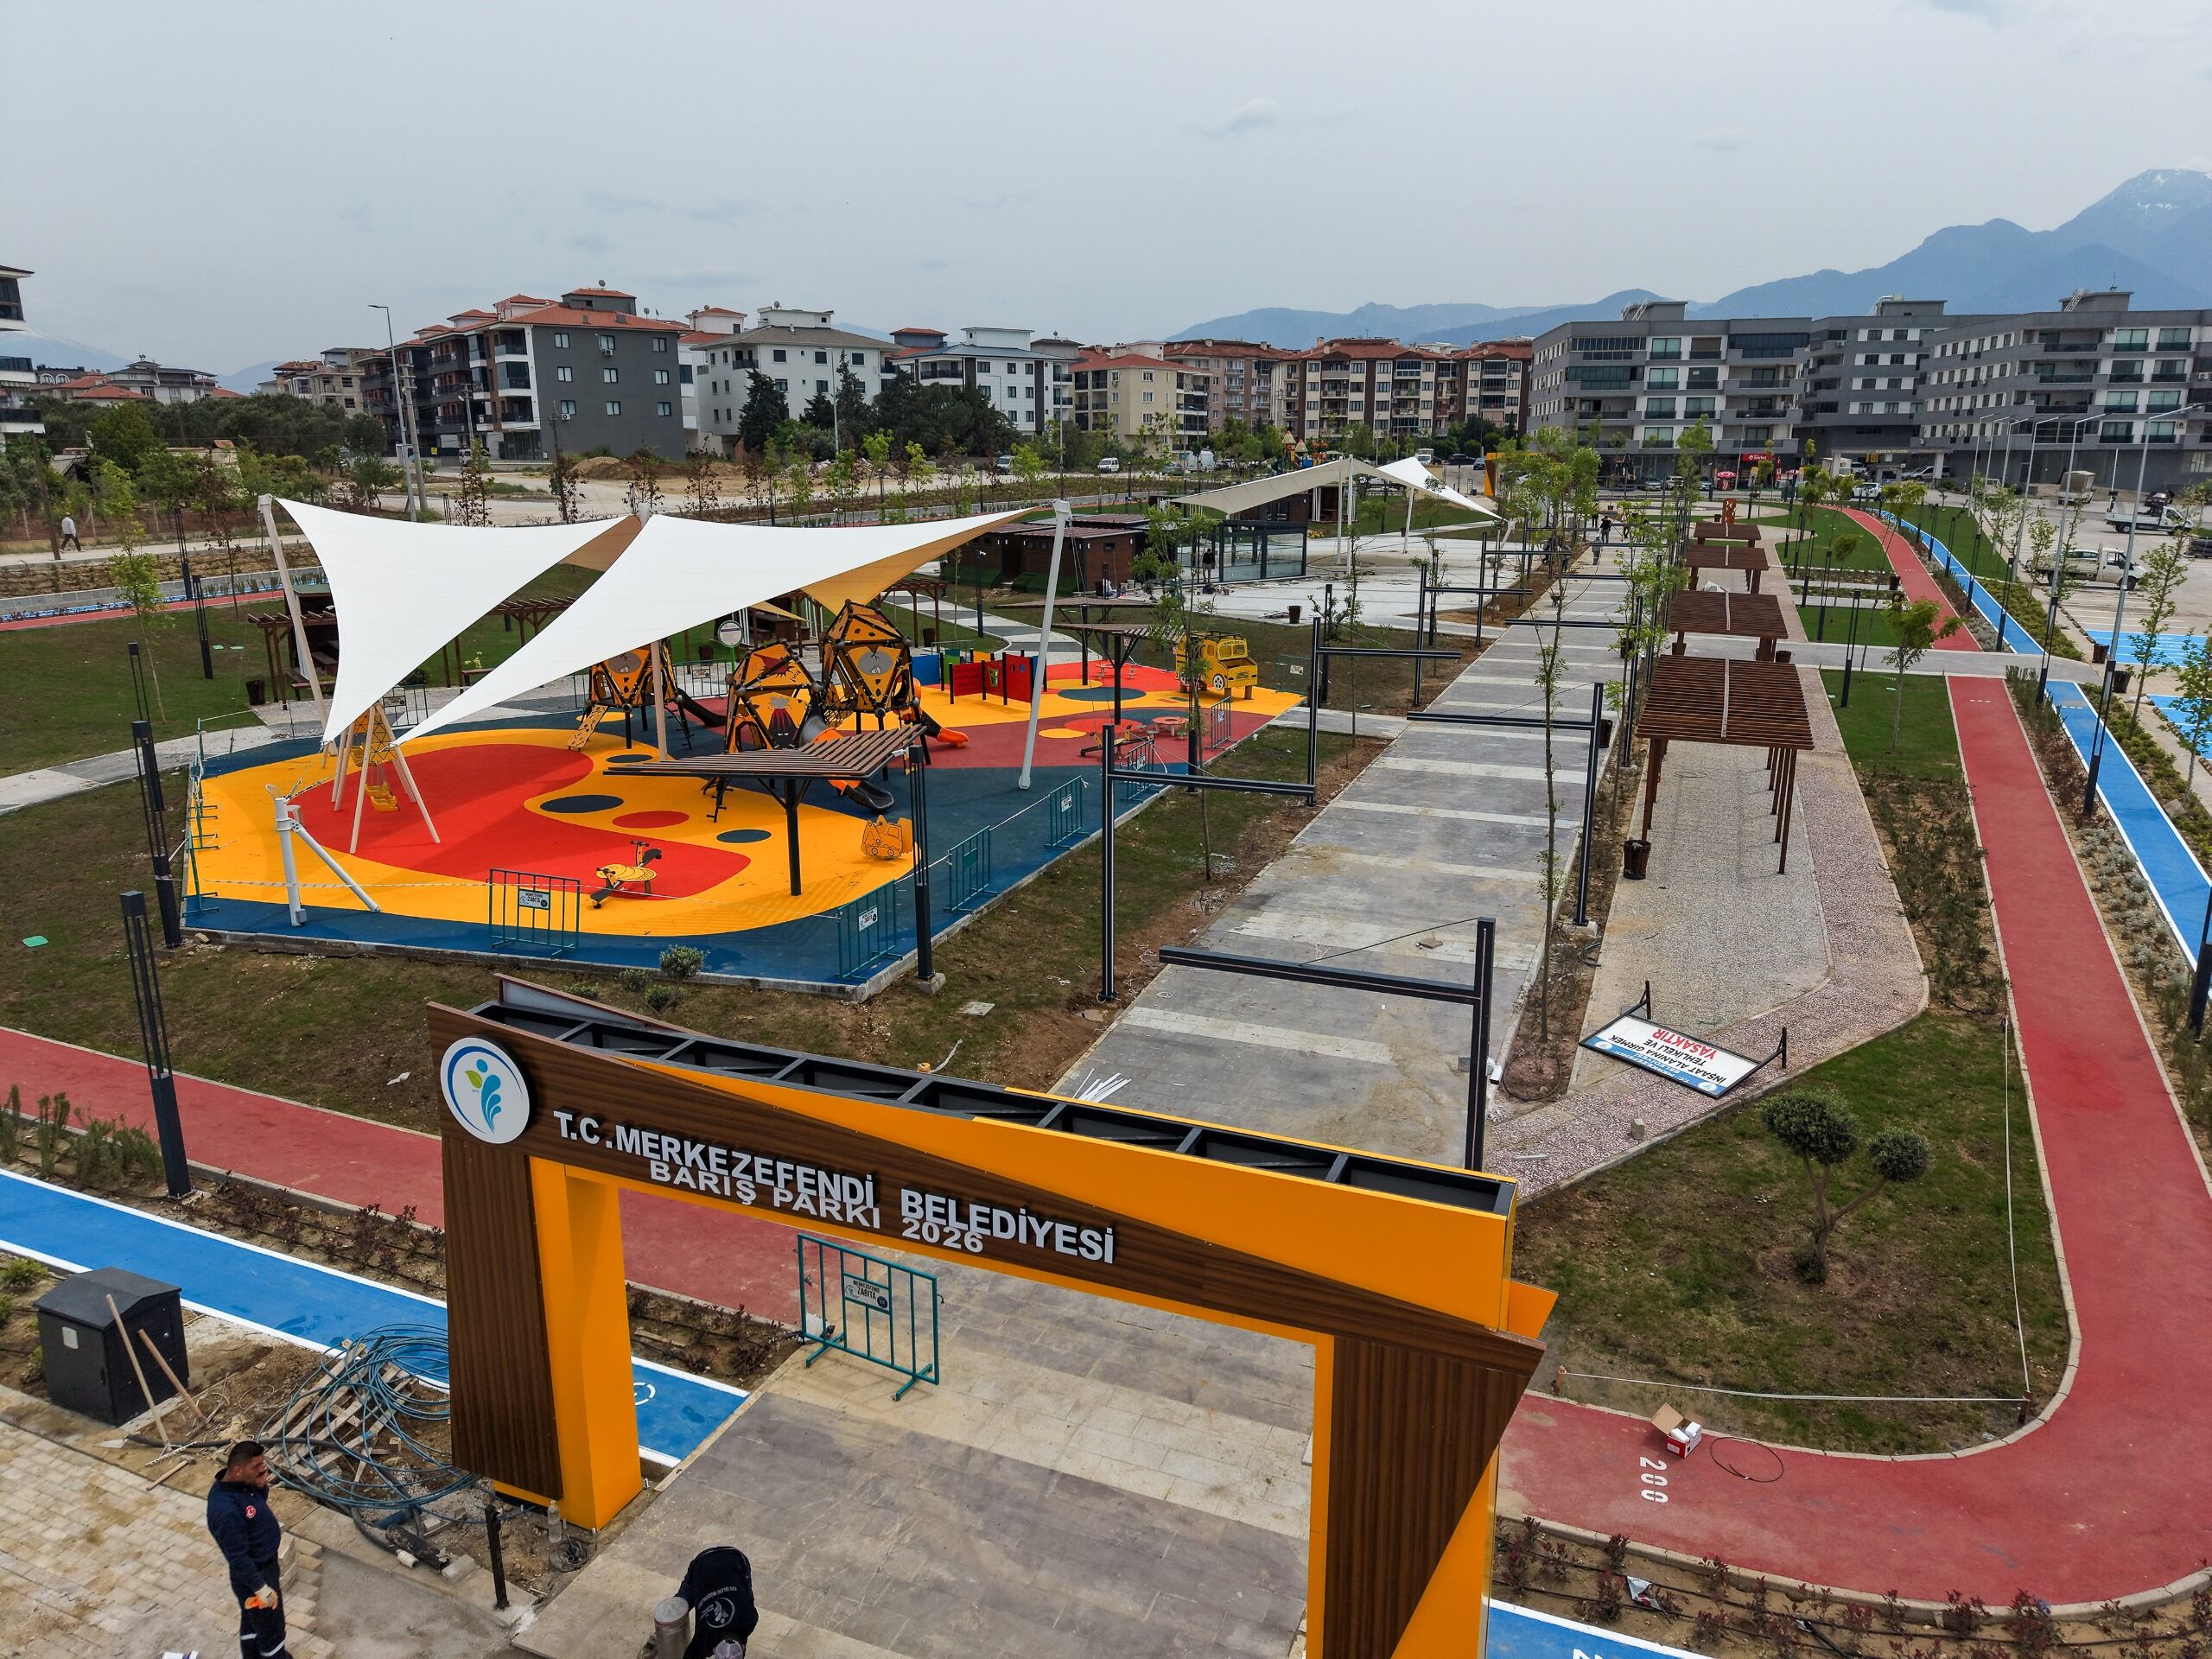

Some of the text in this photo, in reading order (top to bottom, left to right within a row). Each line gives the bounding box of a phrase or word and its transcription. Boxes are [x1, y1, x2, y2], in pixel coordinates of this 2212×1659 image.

[1608, 1034, 1726, 1084] İNŞAAT ALANINA GİRMEK
[1643, 1039, 1706, 1066] TEHLİKELİ VE
[1651, 1027, 1718, 1060] YASAKTIR
[650, 1160, 880, 1229] BARIŞ PARKI
[900, 1188, 1115, 1264] BELEDİYESİ
[901, 1217, 984, 1253] 2026
[857, 1287, 876, 1300] ZABITA
[1639, 1456, 1669, 1503] 200
